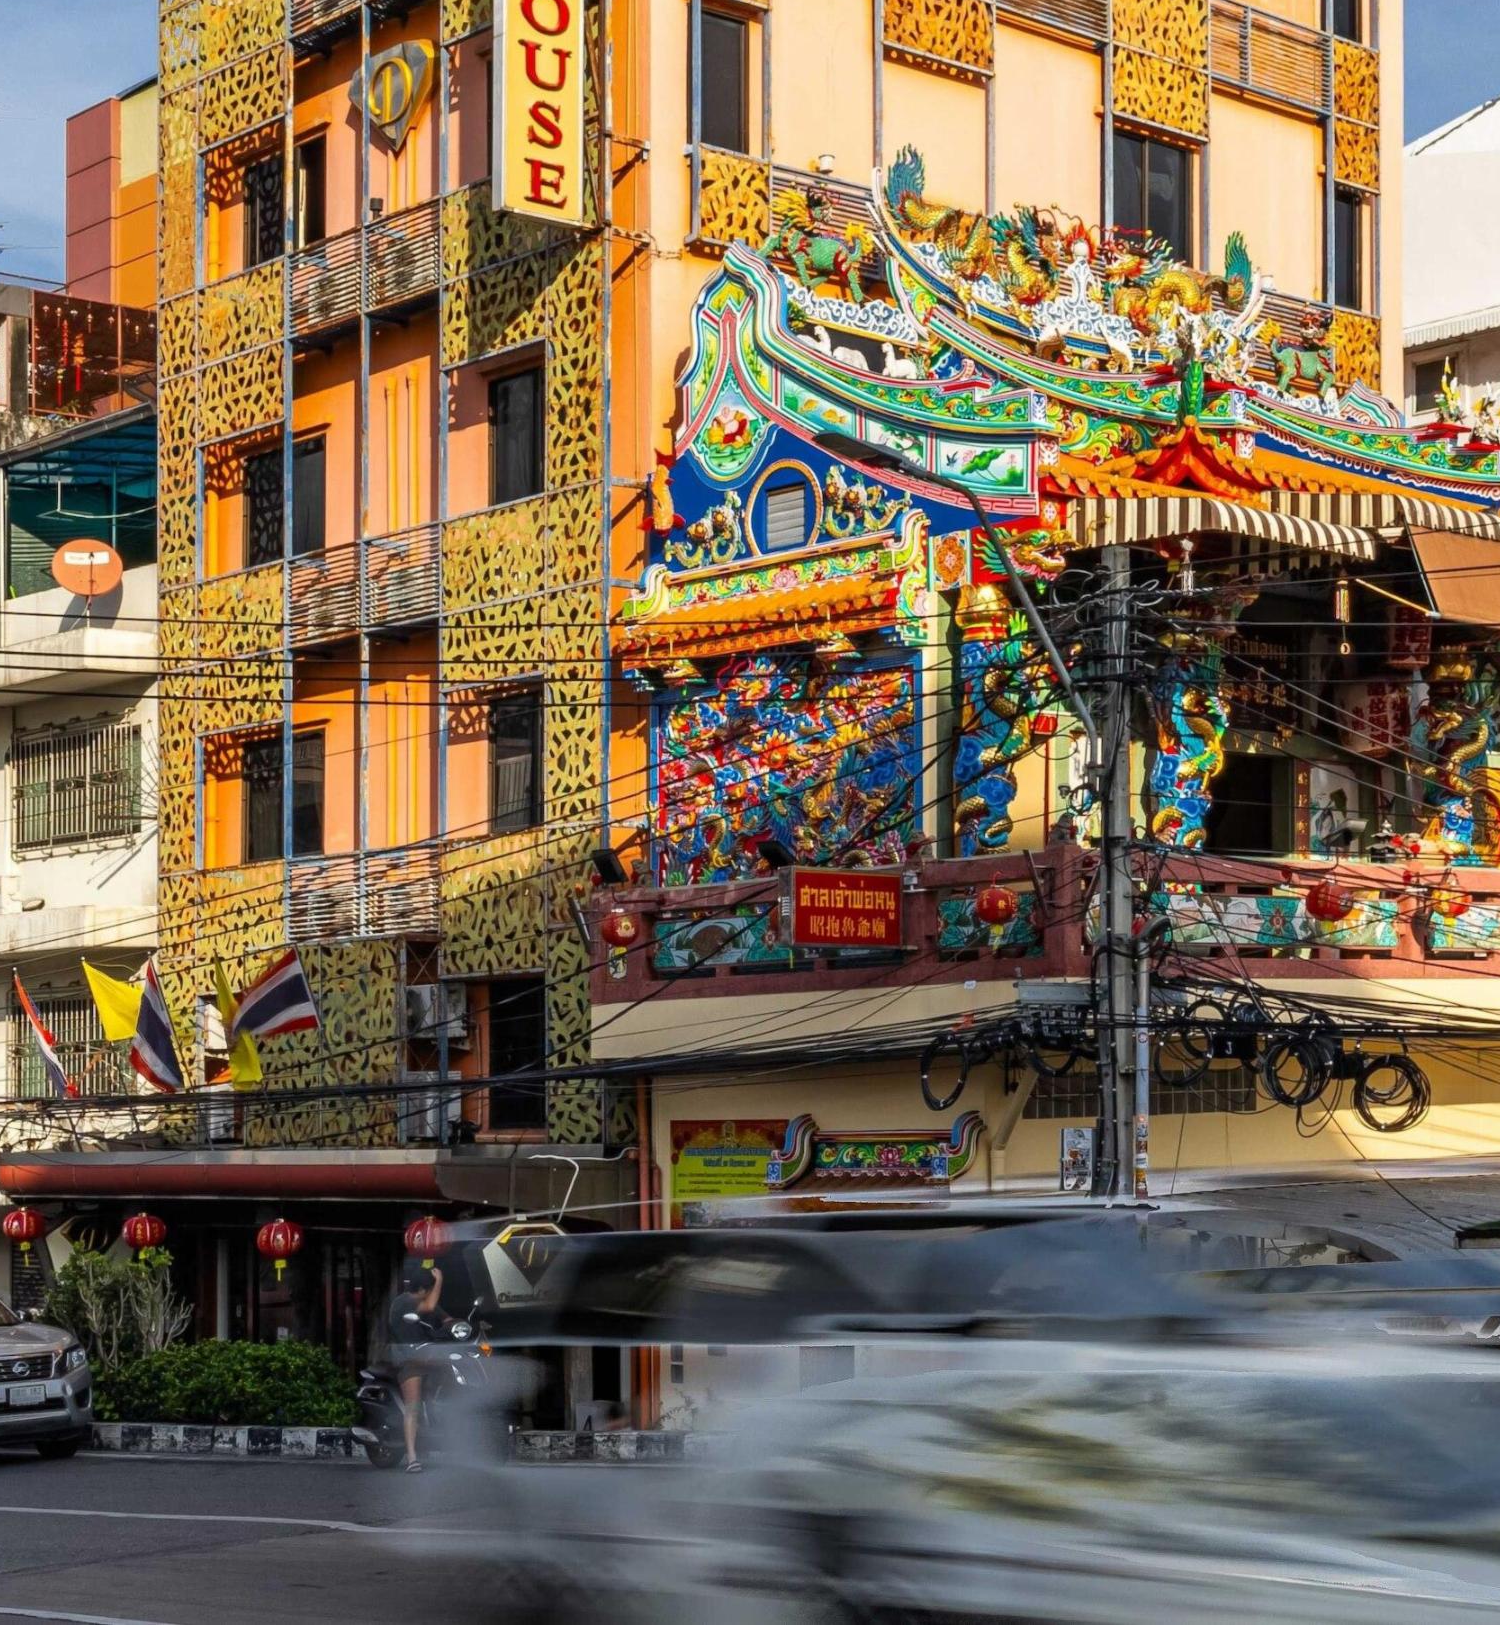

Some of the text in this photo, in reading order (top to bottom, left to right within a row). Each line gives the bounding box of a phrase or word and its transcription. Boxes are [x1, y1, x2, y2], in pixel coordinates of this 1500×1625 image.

[800, 879, 896, 920] ศาลเจ้าพ่อหนู
